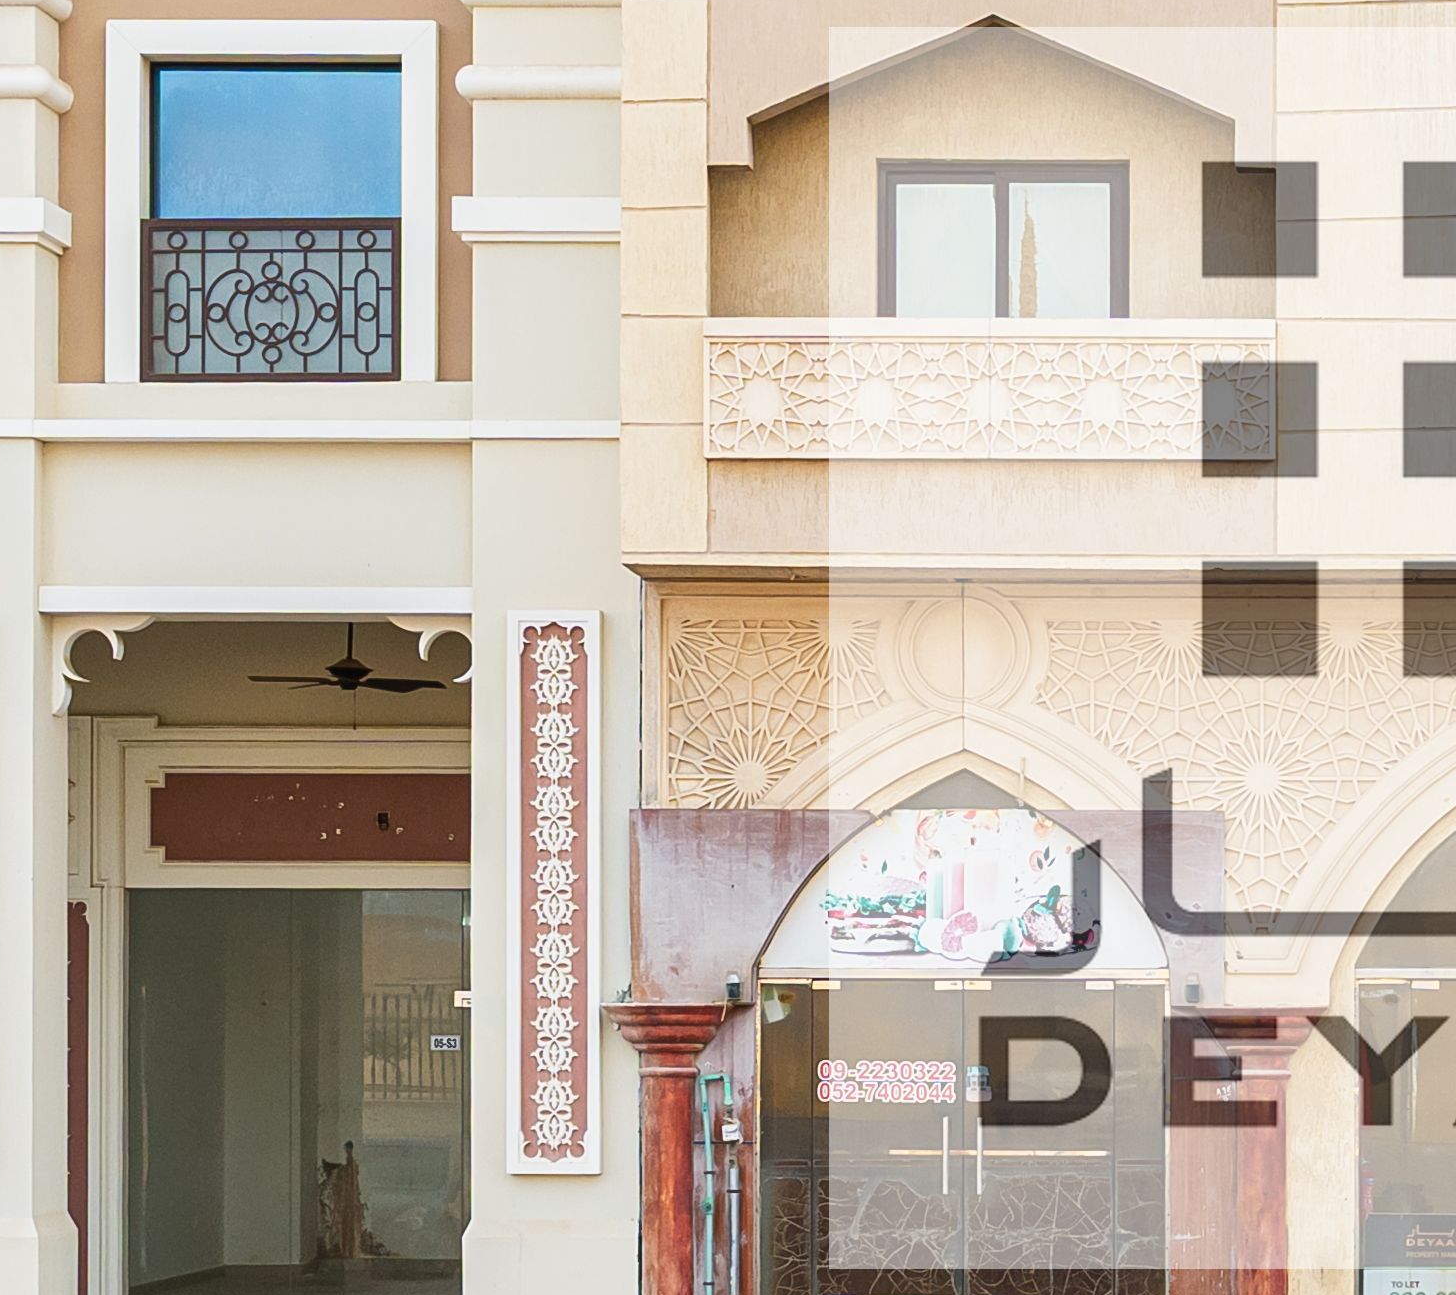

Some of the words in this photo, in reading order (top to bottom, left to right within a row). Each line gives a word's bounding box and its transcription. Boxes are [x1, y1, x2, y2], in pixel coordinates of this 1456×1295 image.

[434, 1038, 457, 1049] 05-S3
[818, 1060, 956, 1082] 09-2230322
[818, 1082, 956, 1103] 052-7402044
[1391, 1281, 1404, 1289] TO
[1404, 1281, 1420, 1289] LET
